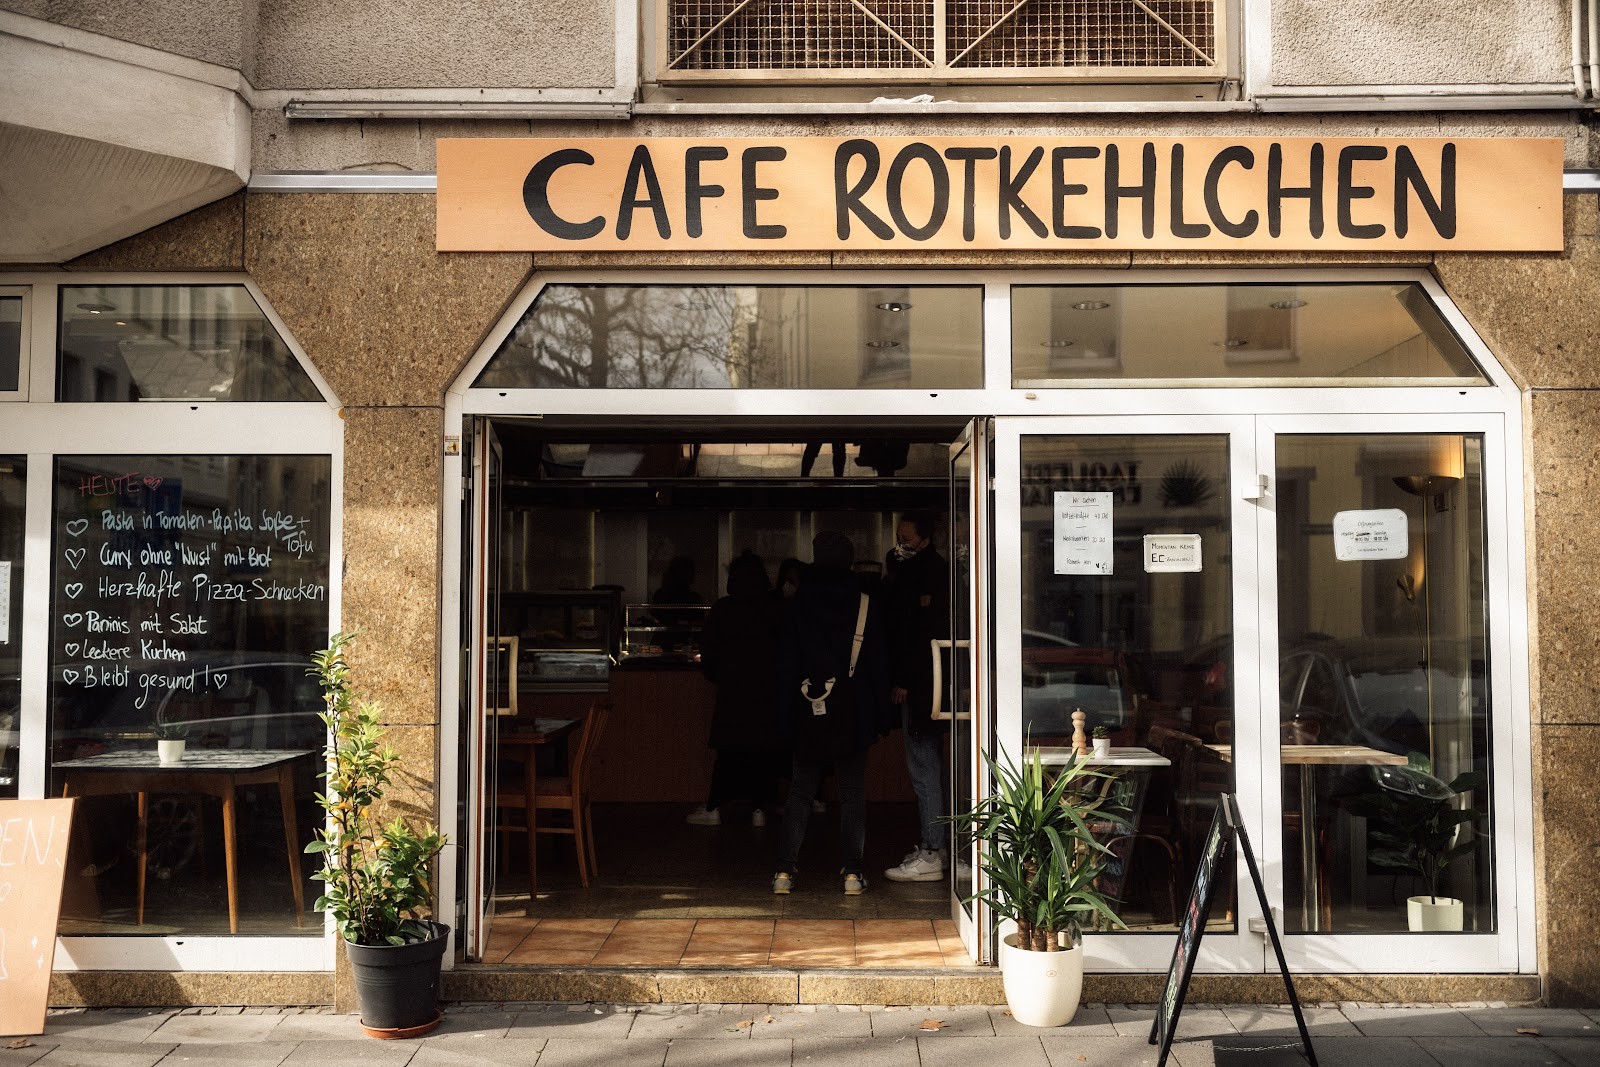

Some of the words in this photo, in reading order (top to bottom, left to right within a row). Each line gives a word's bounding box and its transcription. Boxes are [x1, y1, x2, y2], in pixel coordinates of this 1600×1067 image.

[522, 144, 787, 240] CAFE
[834, 138, 1457, 241] ROTKEHLCHEN
[78, 472, 141, 497] HEUTE
[102, 510, 134, 531] Pasta
[142, 511, 153, 530] in
[100, 542, 132, 569] Curry
[140, 542, 172, 565] ohne
[224, 546, 246, 566] mit
[248, 546, 273, 567] Brot
[282, 530, 314, 560] Tofu
[99, 569, 182, 607] Herzhafte
[85, 610, 131, 634] Paninis
[140, 613, 163, 633] mit
[170, 613, 208, 635] Salat
[82, 639, 131, 661] Leckere
[140, 638, 187, 662] Kuchen
[84, 664, 130, 689] Bleibt
[134, 668, 195, 710] gesund
